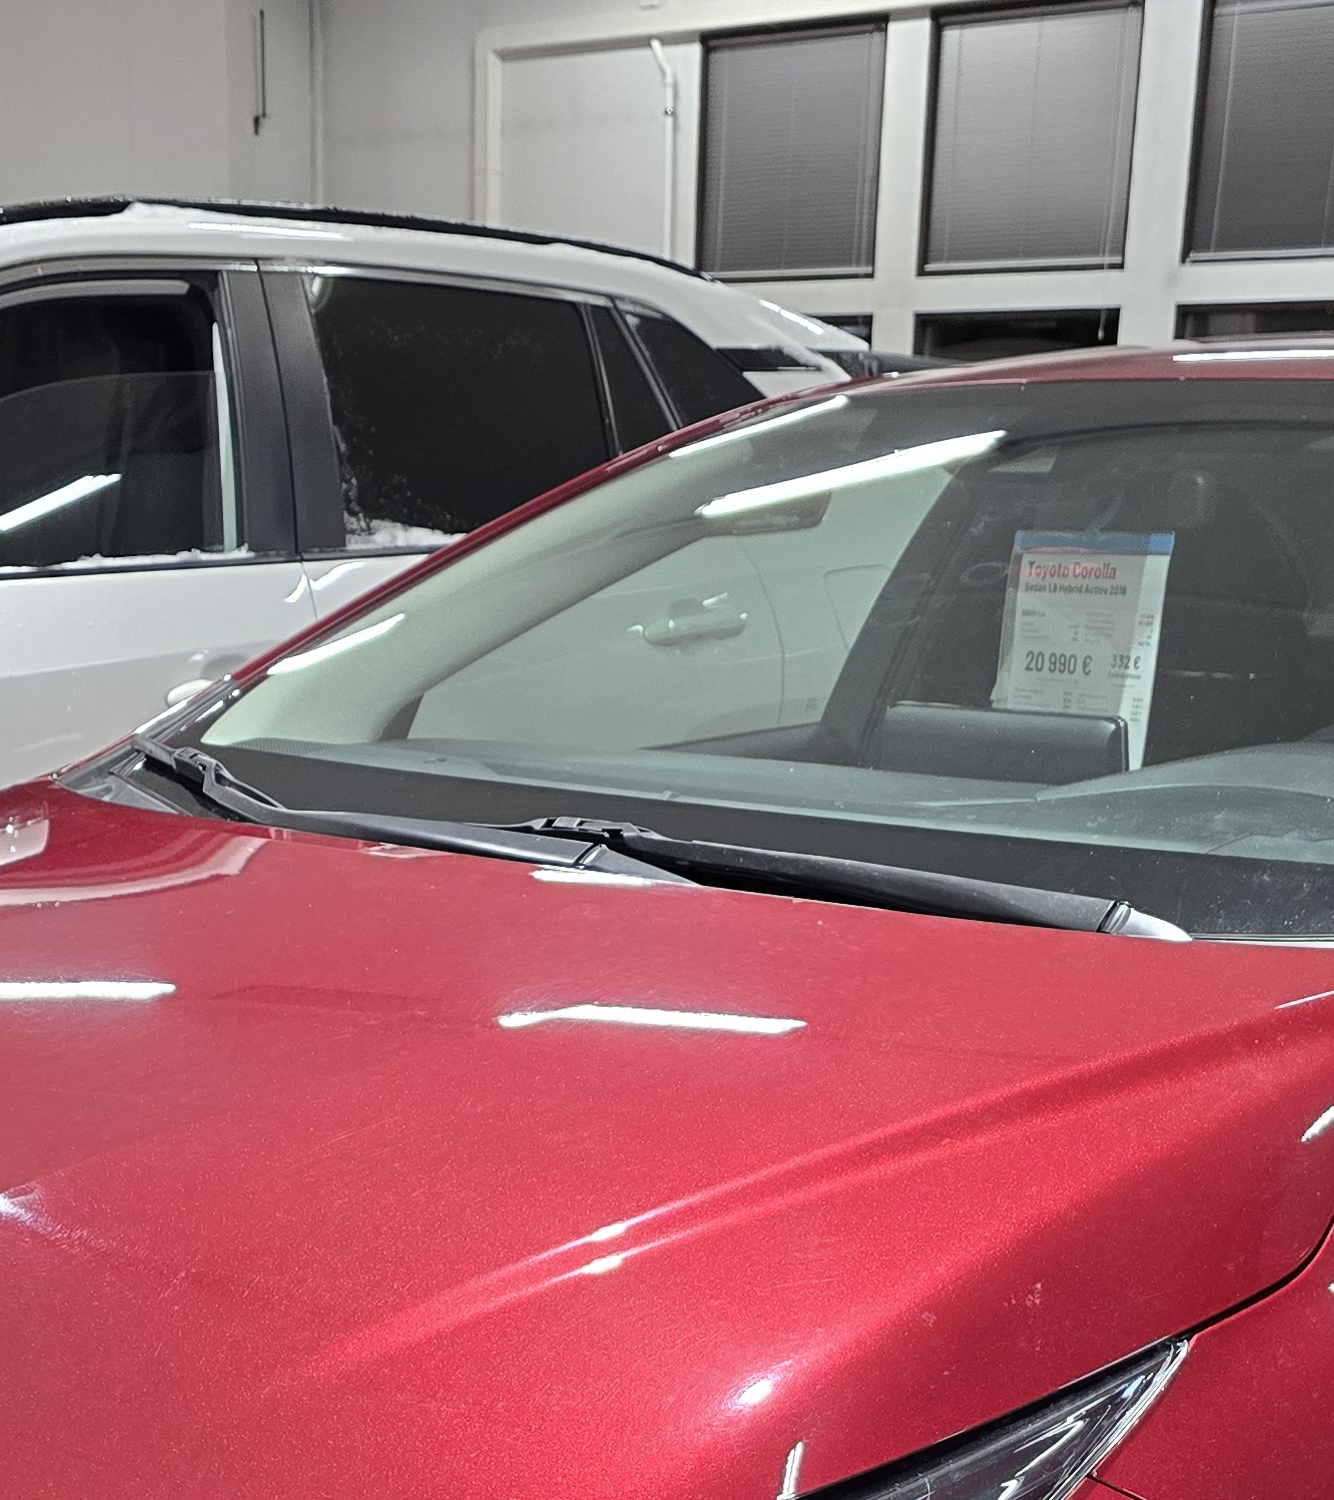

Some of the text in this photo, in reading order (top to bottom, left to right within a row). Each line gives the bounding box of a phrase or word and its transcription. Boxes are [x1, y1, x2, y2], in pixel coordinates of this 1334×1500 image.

[1027, 560, 1117, 580] Toyota Corolla
[1024, 650, 1045, 672] 20
[1048, 652, 1078, 675] 990
[1082, 654, 1093, 676] €
[1110, 653, 1142, 670] 332 €
